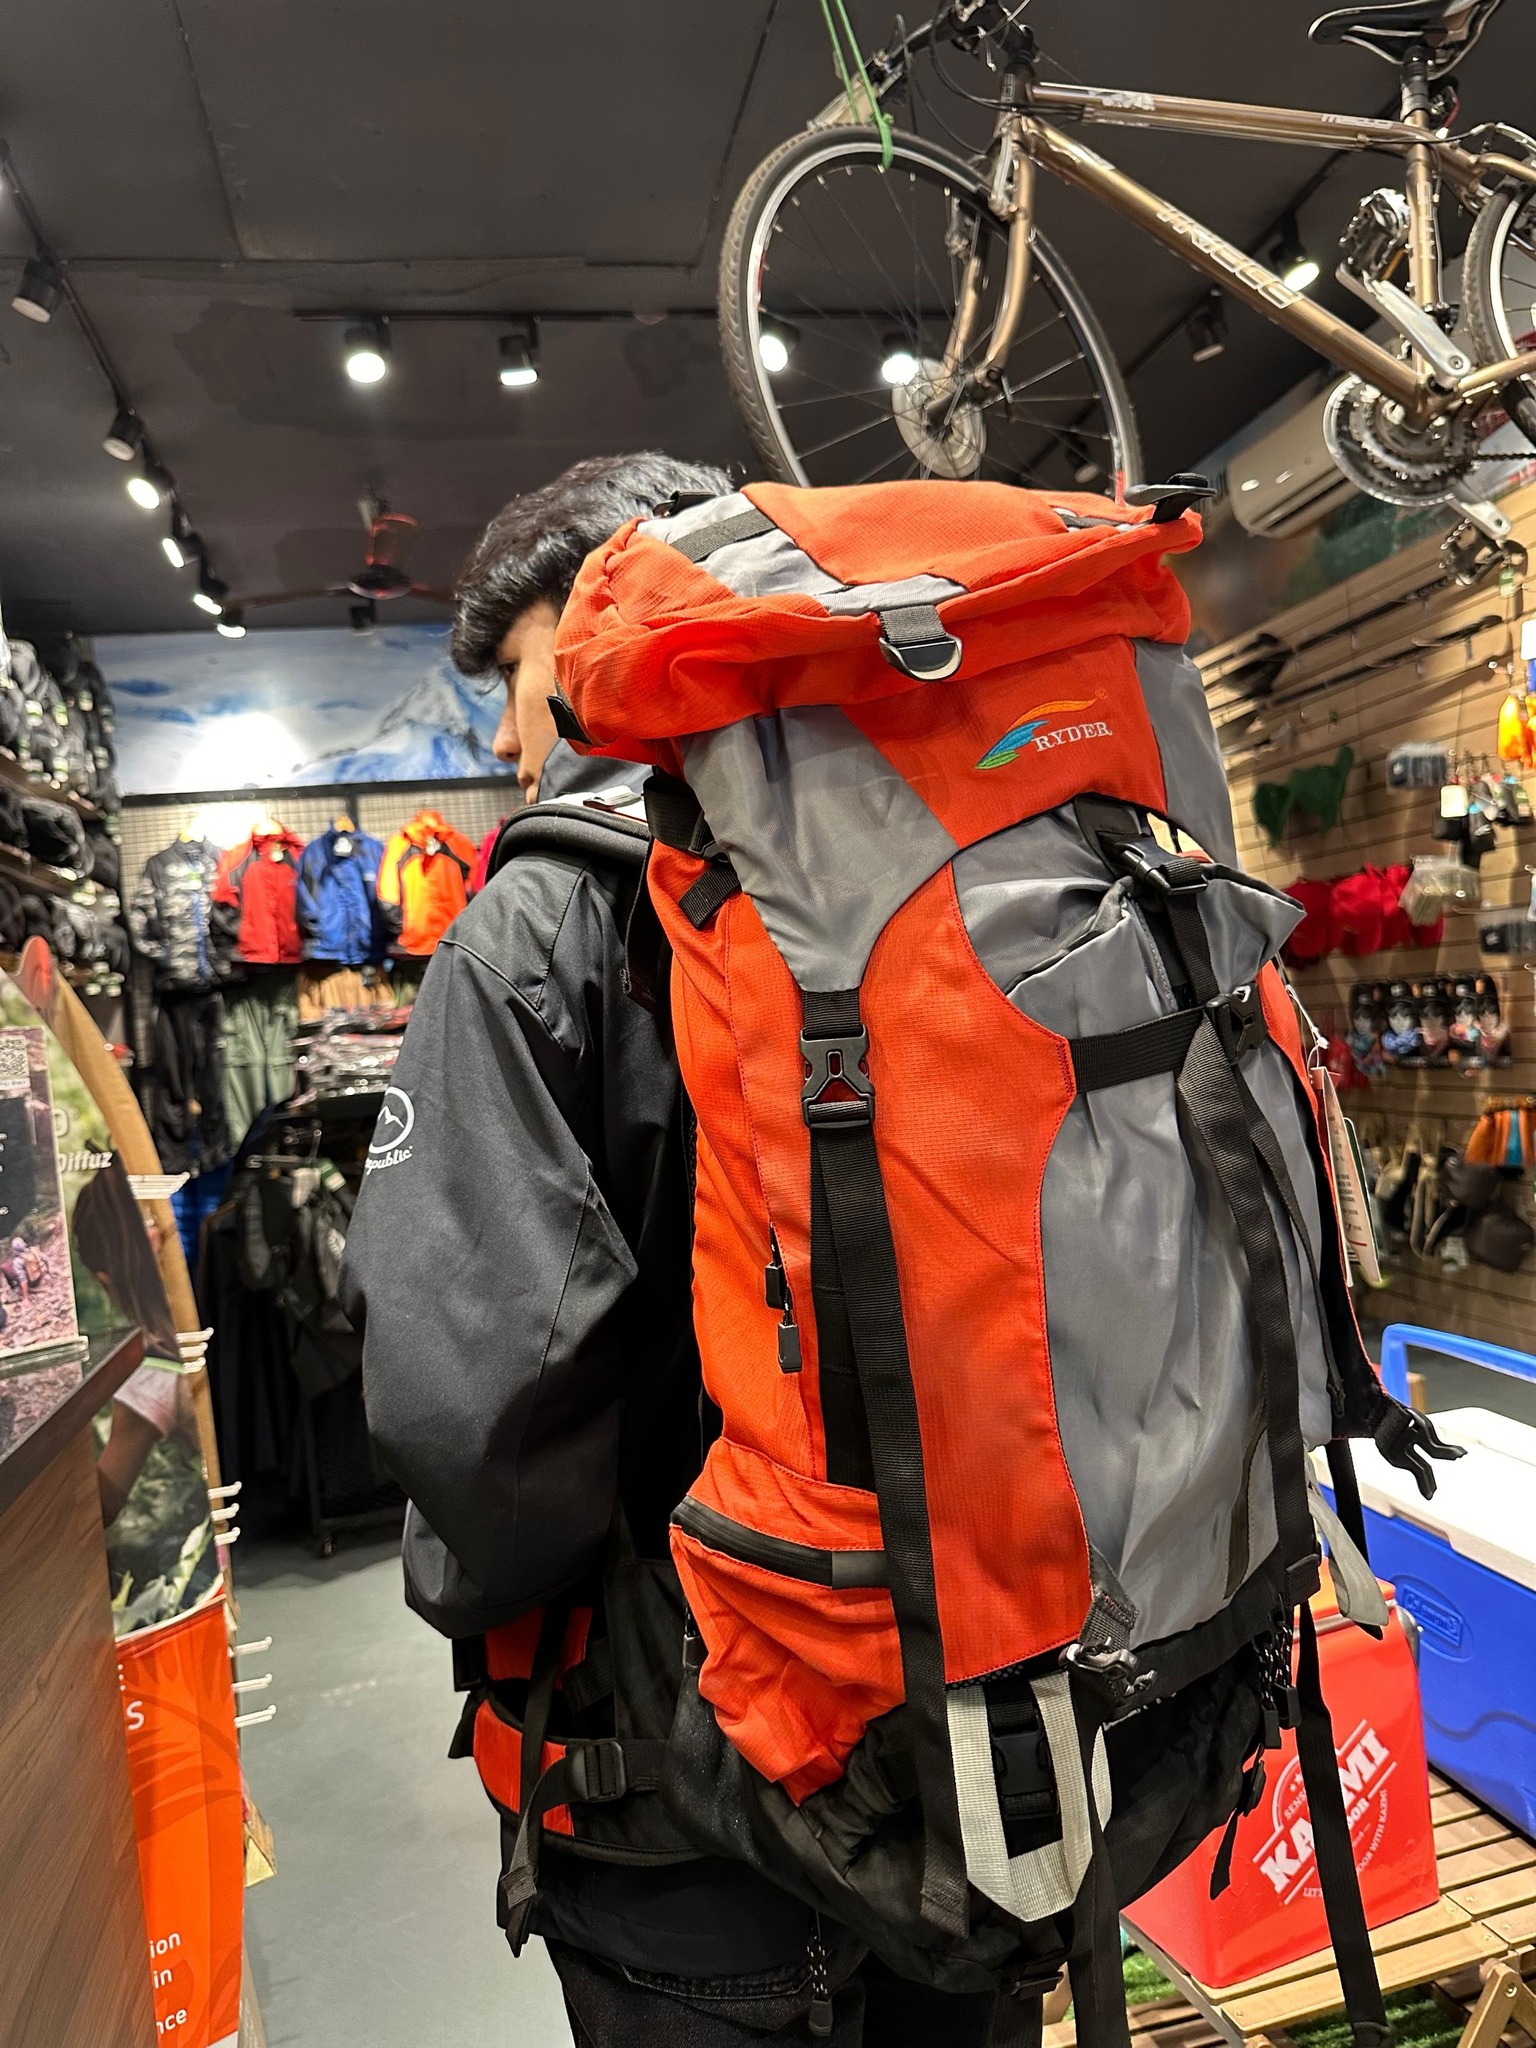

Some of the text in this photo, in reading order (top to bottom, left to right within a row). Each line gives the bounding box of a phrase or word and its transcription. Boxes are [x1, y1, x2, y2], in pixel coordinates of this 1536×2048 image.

[1031, 721, 1113, 752] RYDER
[364, 1148, 413, 1176] epublic
[1259, 1727, 1390, 1894] KAMI
[149, 1932, 181, 1959] ion
[156, 2009, 188, 2035] nce
